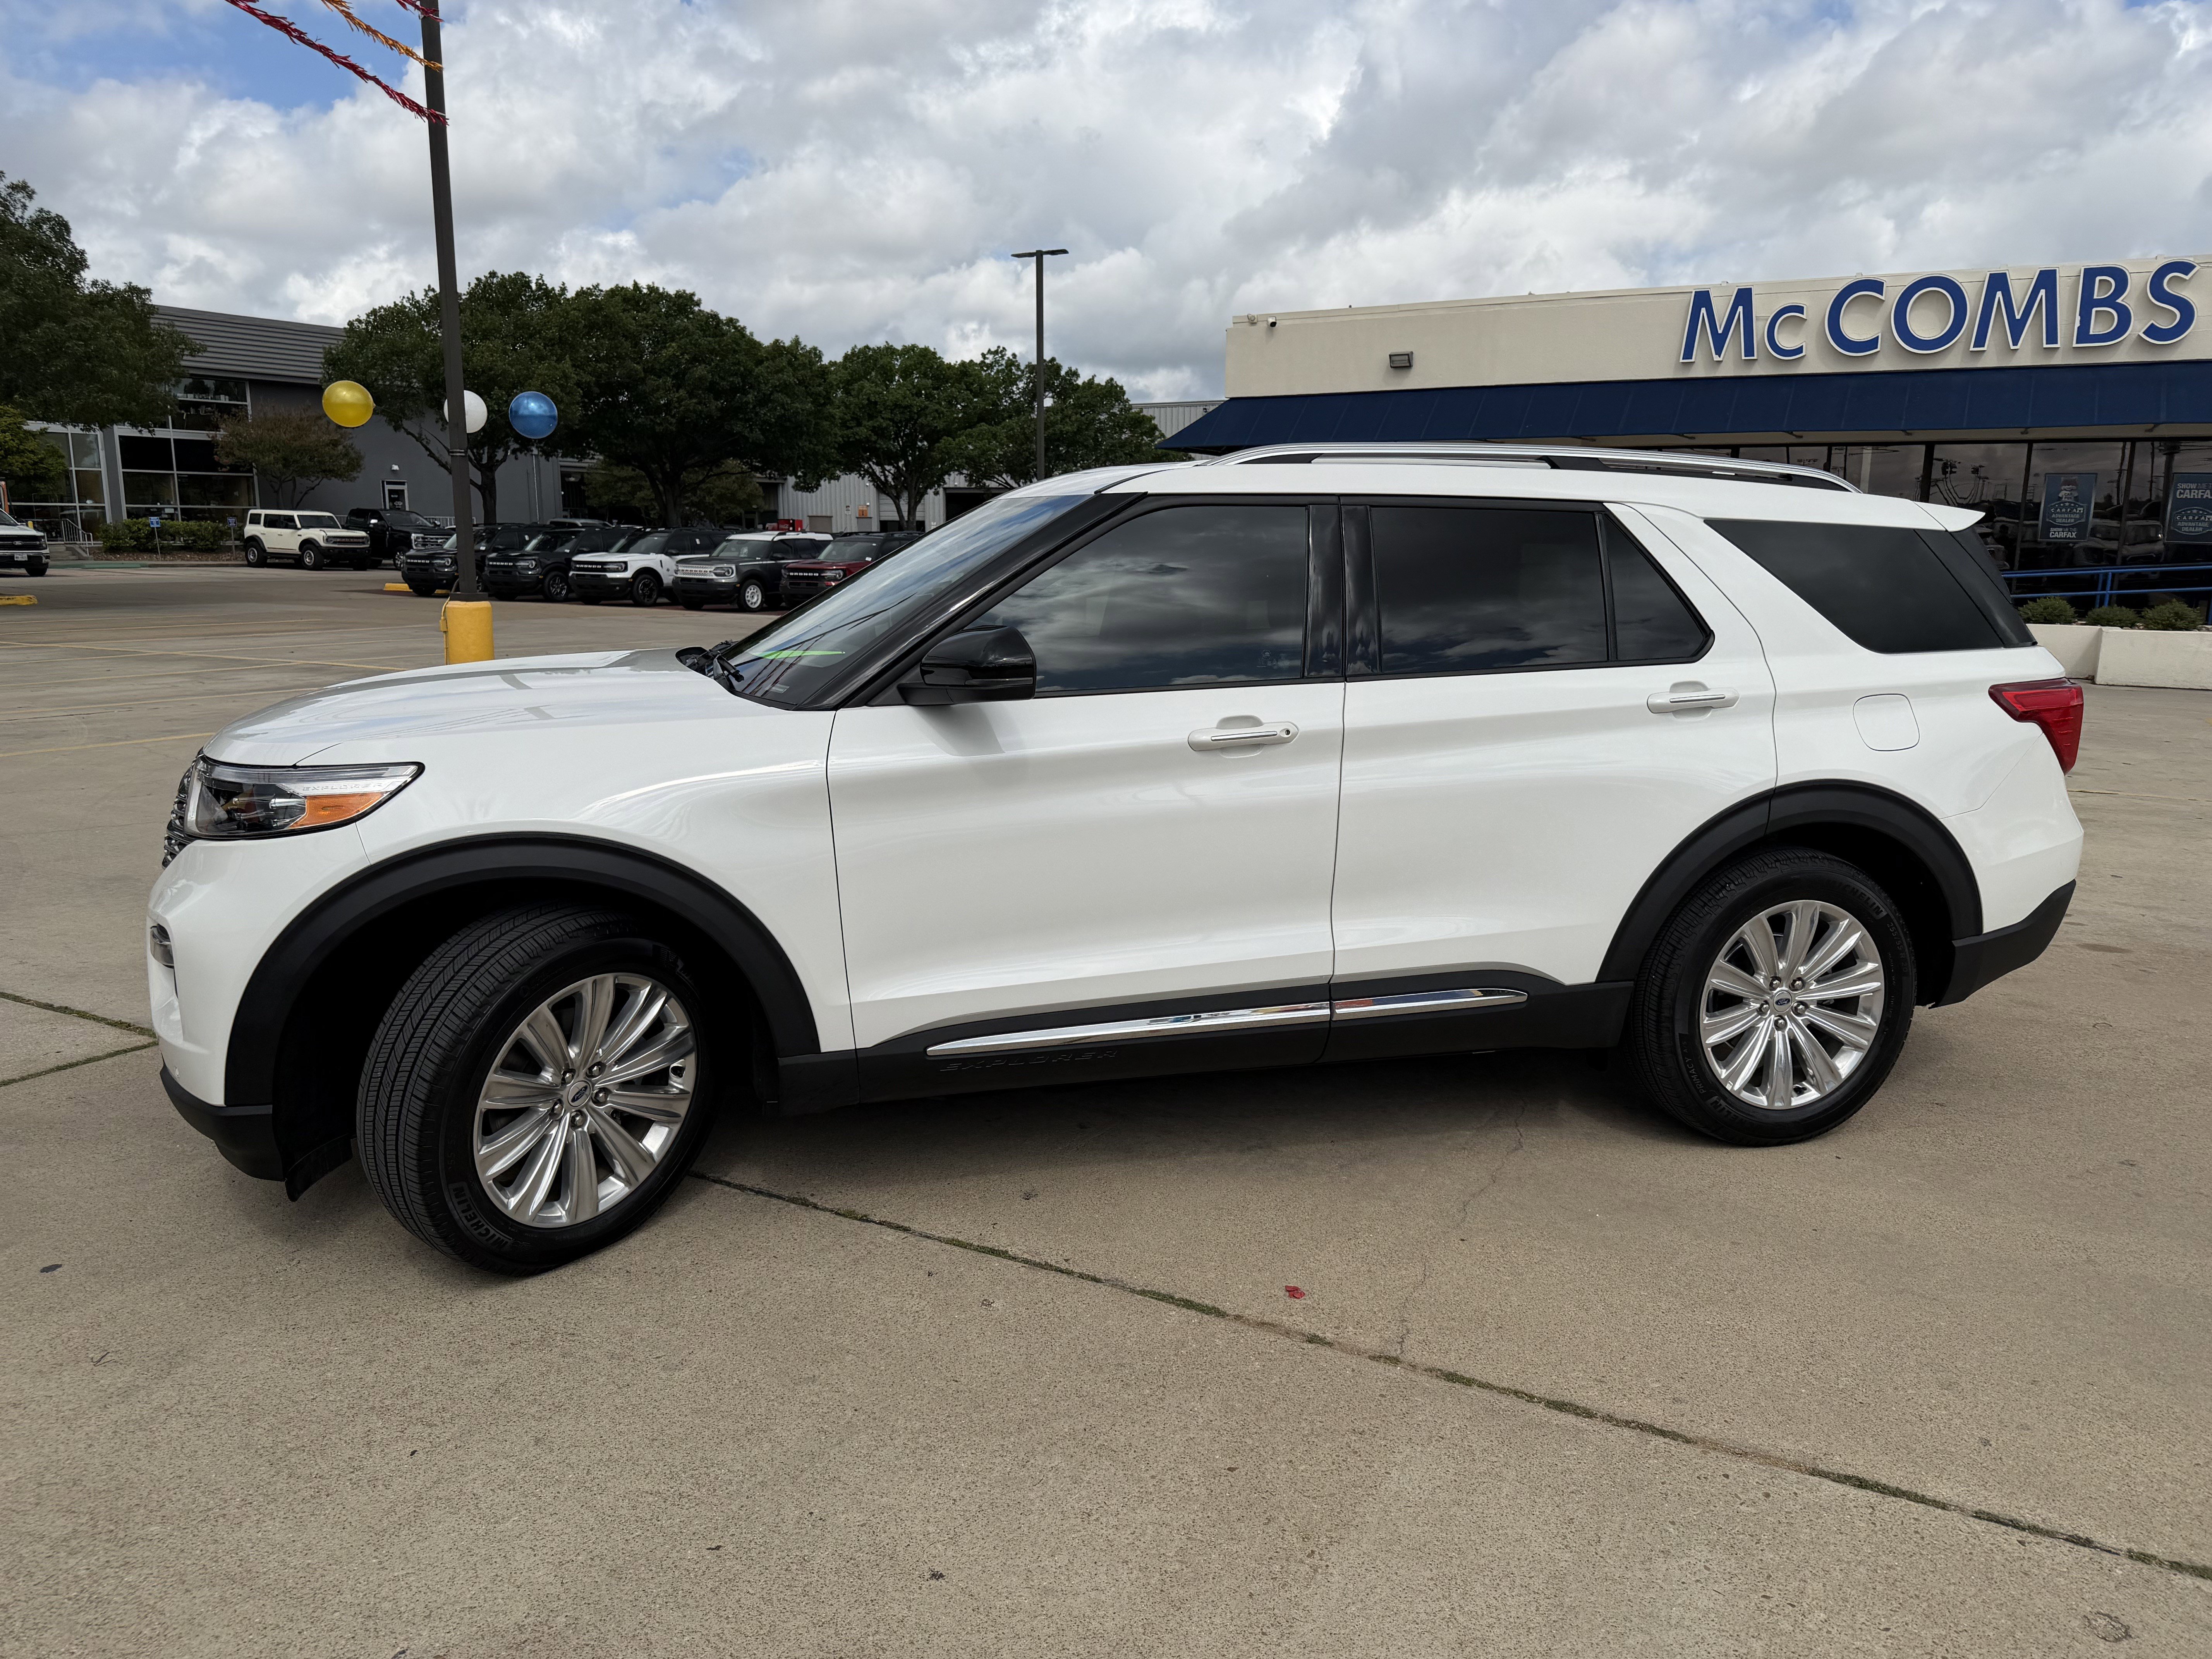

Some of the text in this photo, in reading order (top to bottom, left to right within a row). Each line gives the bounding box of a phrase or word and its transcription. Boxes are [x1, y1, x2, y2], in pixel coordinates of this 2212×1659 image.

[1679, 258, 2201, 363] McCOMBS
[2176, 489, 2212, 498] CARFA
[302, 783, 383, 791] EXPLORER
[939, 1050, 1118, 1072] EXPLORER
[1685, 1057, 1707, 1094] PRIMACY
[453, 1186, 509, 1249] MICHELIN
